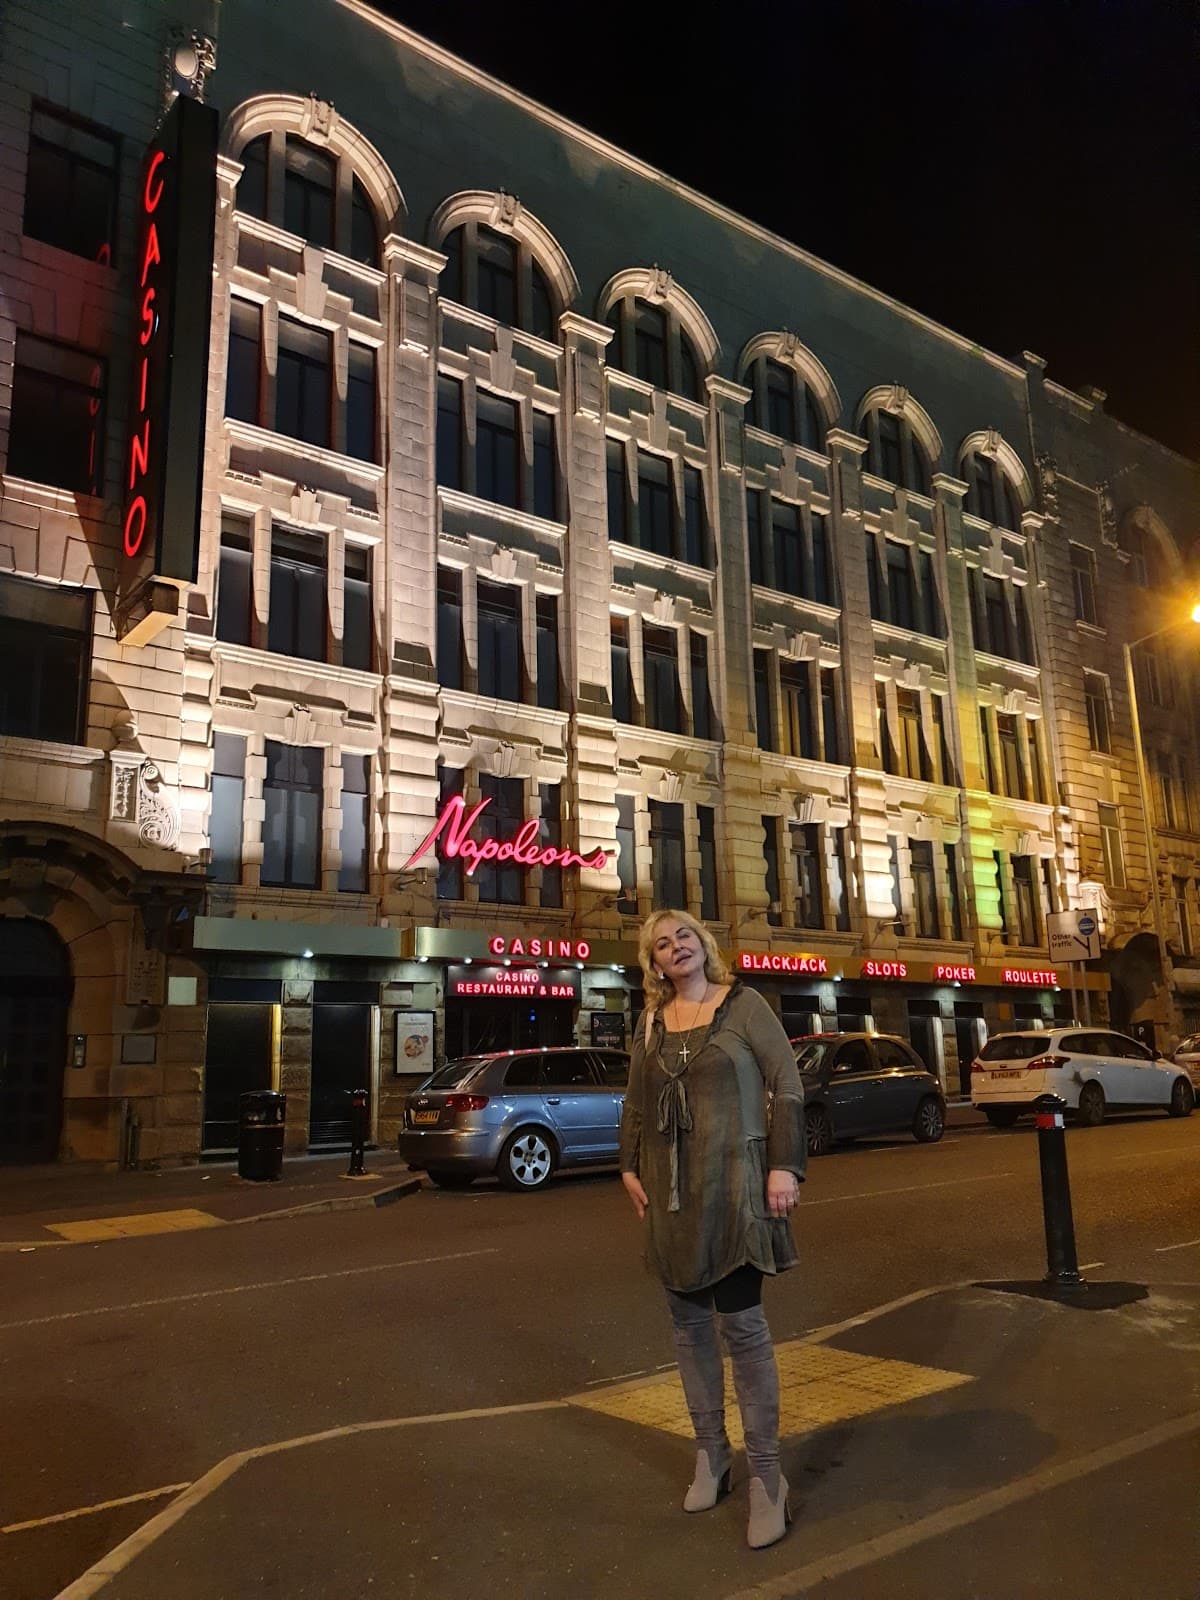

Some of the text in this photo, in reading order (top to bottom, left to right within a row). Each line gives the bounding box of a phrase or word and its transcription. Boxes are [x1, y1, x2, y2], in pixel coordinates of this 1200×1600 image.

[124, 152, 165, 558] CASINO
[404, 795, 617, 876] Napoleons
[492, 937, 591, 959] CASINO
[1052, 941, 1072, 949] traffic
[741, 954, 828, 973] BLACKJACK
[866, 961, 908, 978] SLOTS
[495, 972, 540, 983] CASINO
[937, 966, 976, 981] POKER
[1005, 970, 1057, 985] ROULETTE
[457, 983, 574, 996] RESTAURANT & BAR
